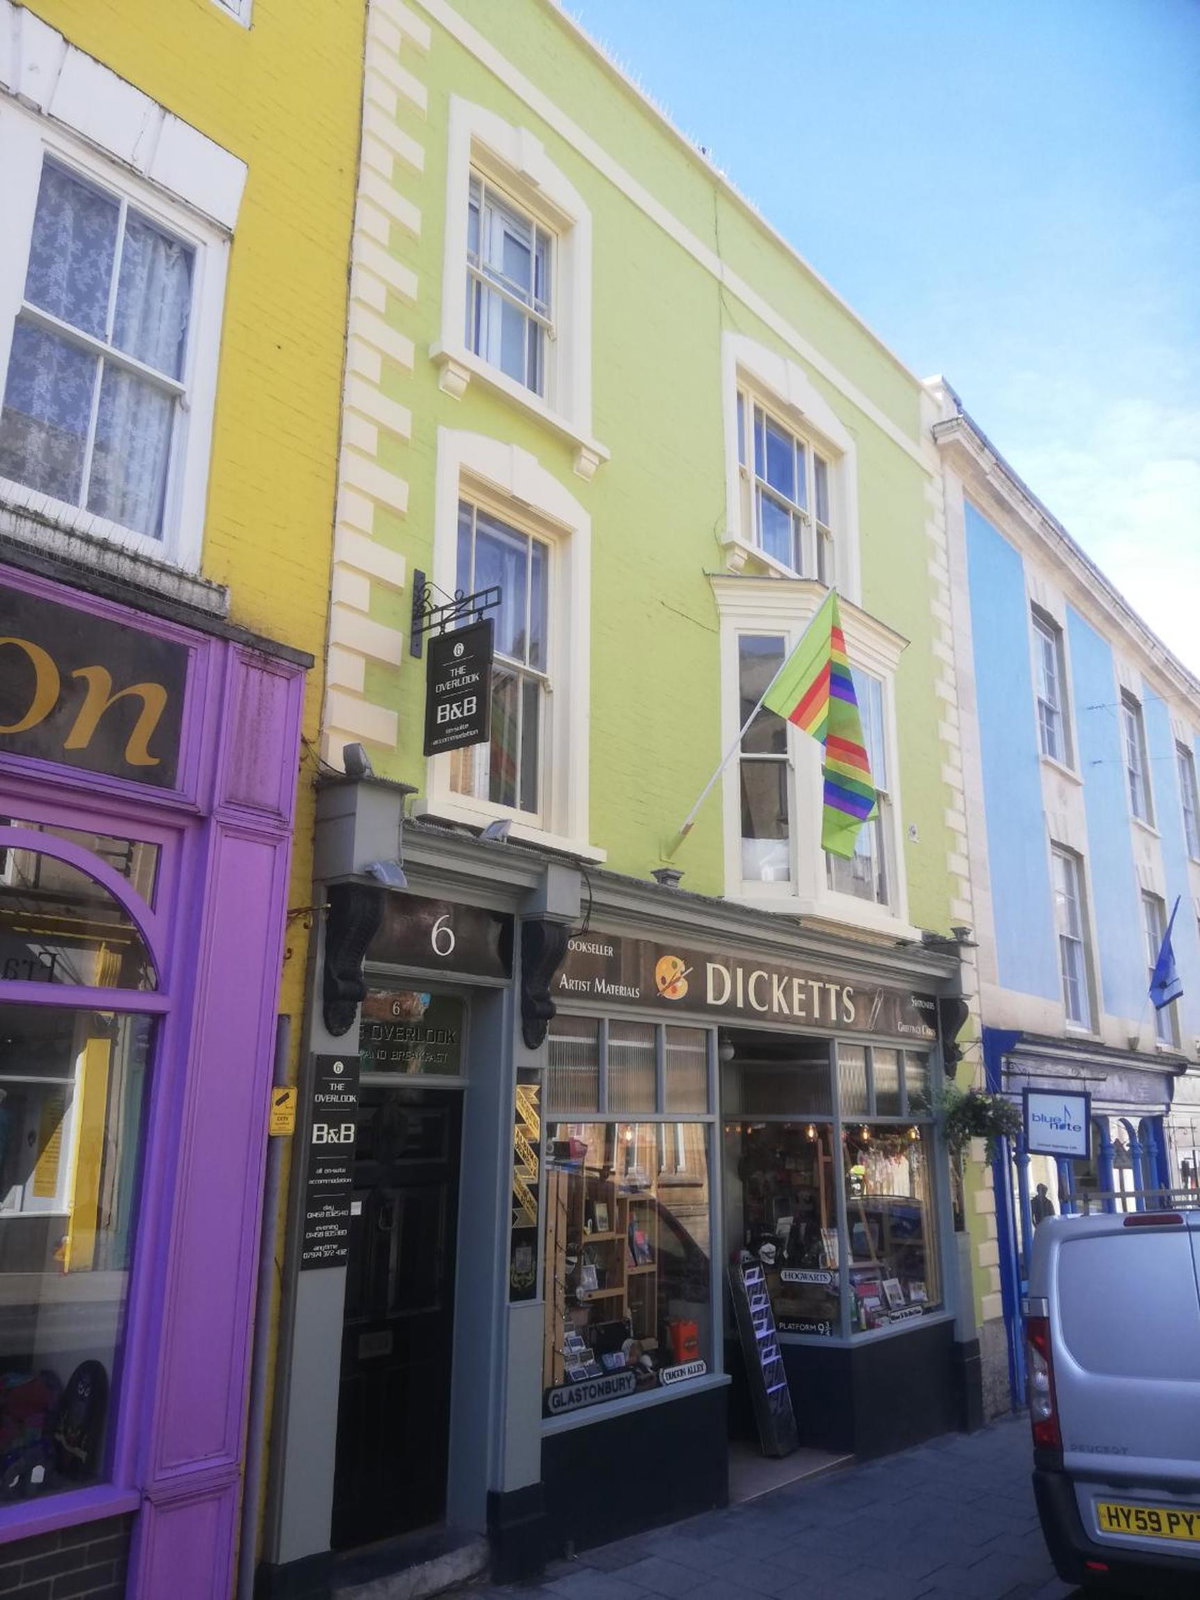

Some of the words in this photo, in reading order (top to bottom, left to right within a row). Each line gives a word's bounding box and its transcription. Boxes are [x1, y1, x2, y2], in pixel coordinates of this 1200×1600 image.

[449, 665, 467, 677] THE
[435, 672, 480, 693] OVERLOOK
[436, 696, 477, 724] B&B
[431, 914, 456, 957] 6
[567, 939, 614, 957] OOKSELLER
[559, 973, 591, 991] ARTIST
[594, 977, 640, 999] MATERIALS
[706, 962, 855, 1024] DICKETTS
[392, 1001, 401, 1015] 6
[371, 1025, 456, 1045] OVERLOOK
[329, 1083, 345, 1091] THE
[314, 1094, 357, 1103] OVERLOOK
[1031, 1112, 1062, 1123] blue
[312, 1123, 355, 1144] B&B
[783, 1271, 830, 1282] HOGWARTS
[779, 1322, 817, 1331] PLATFORM
[687, 1363, 704, 1376] ALLEY
[551, 1376, 633, 1409] GLASTONBURY
[1070, 1443, 1129, 1455] PEUGEOT
[1106, 1506, 1162, 1532] HY59
[1167, 1513, 1200, 1536] PY
